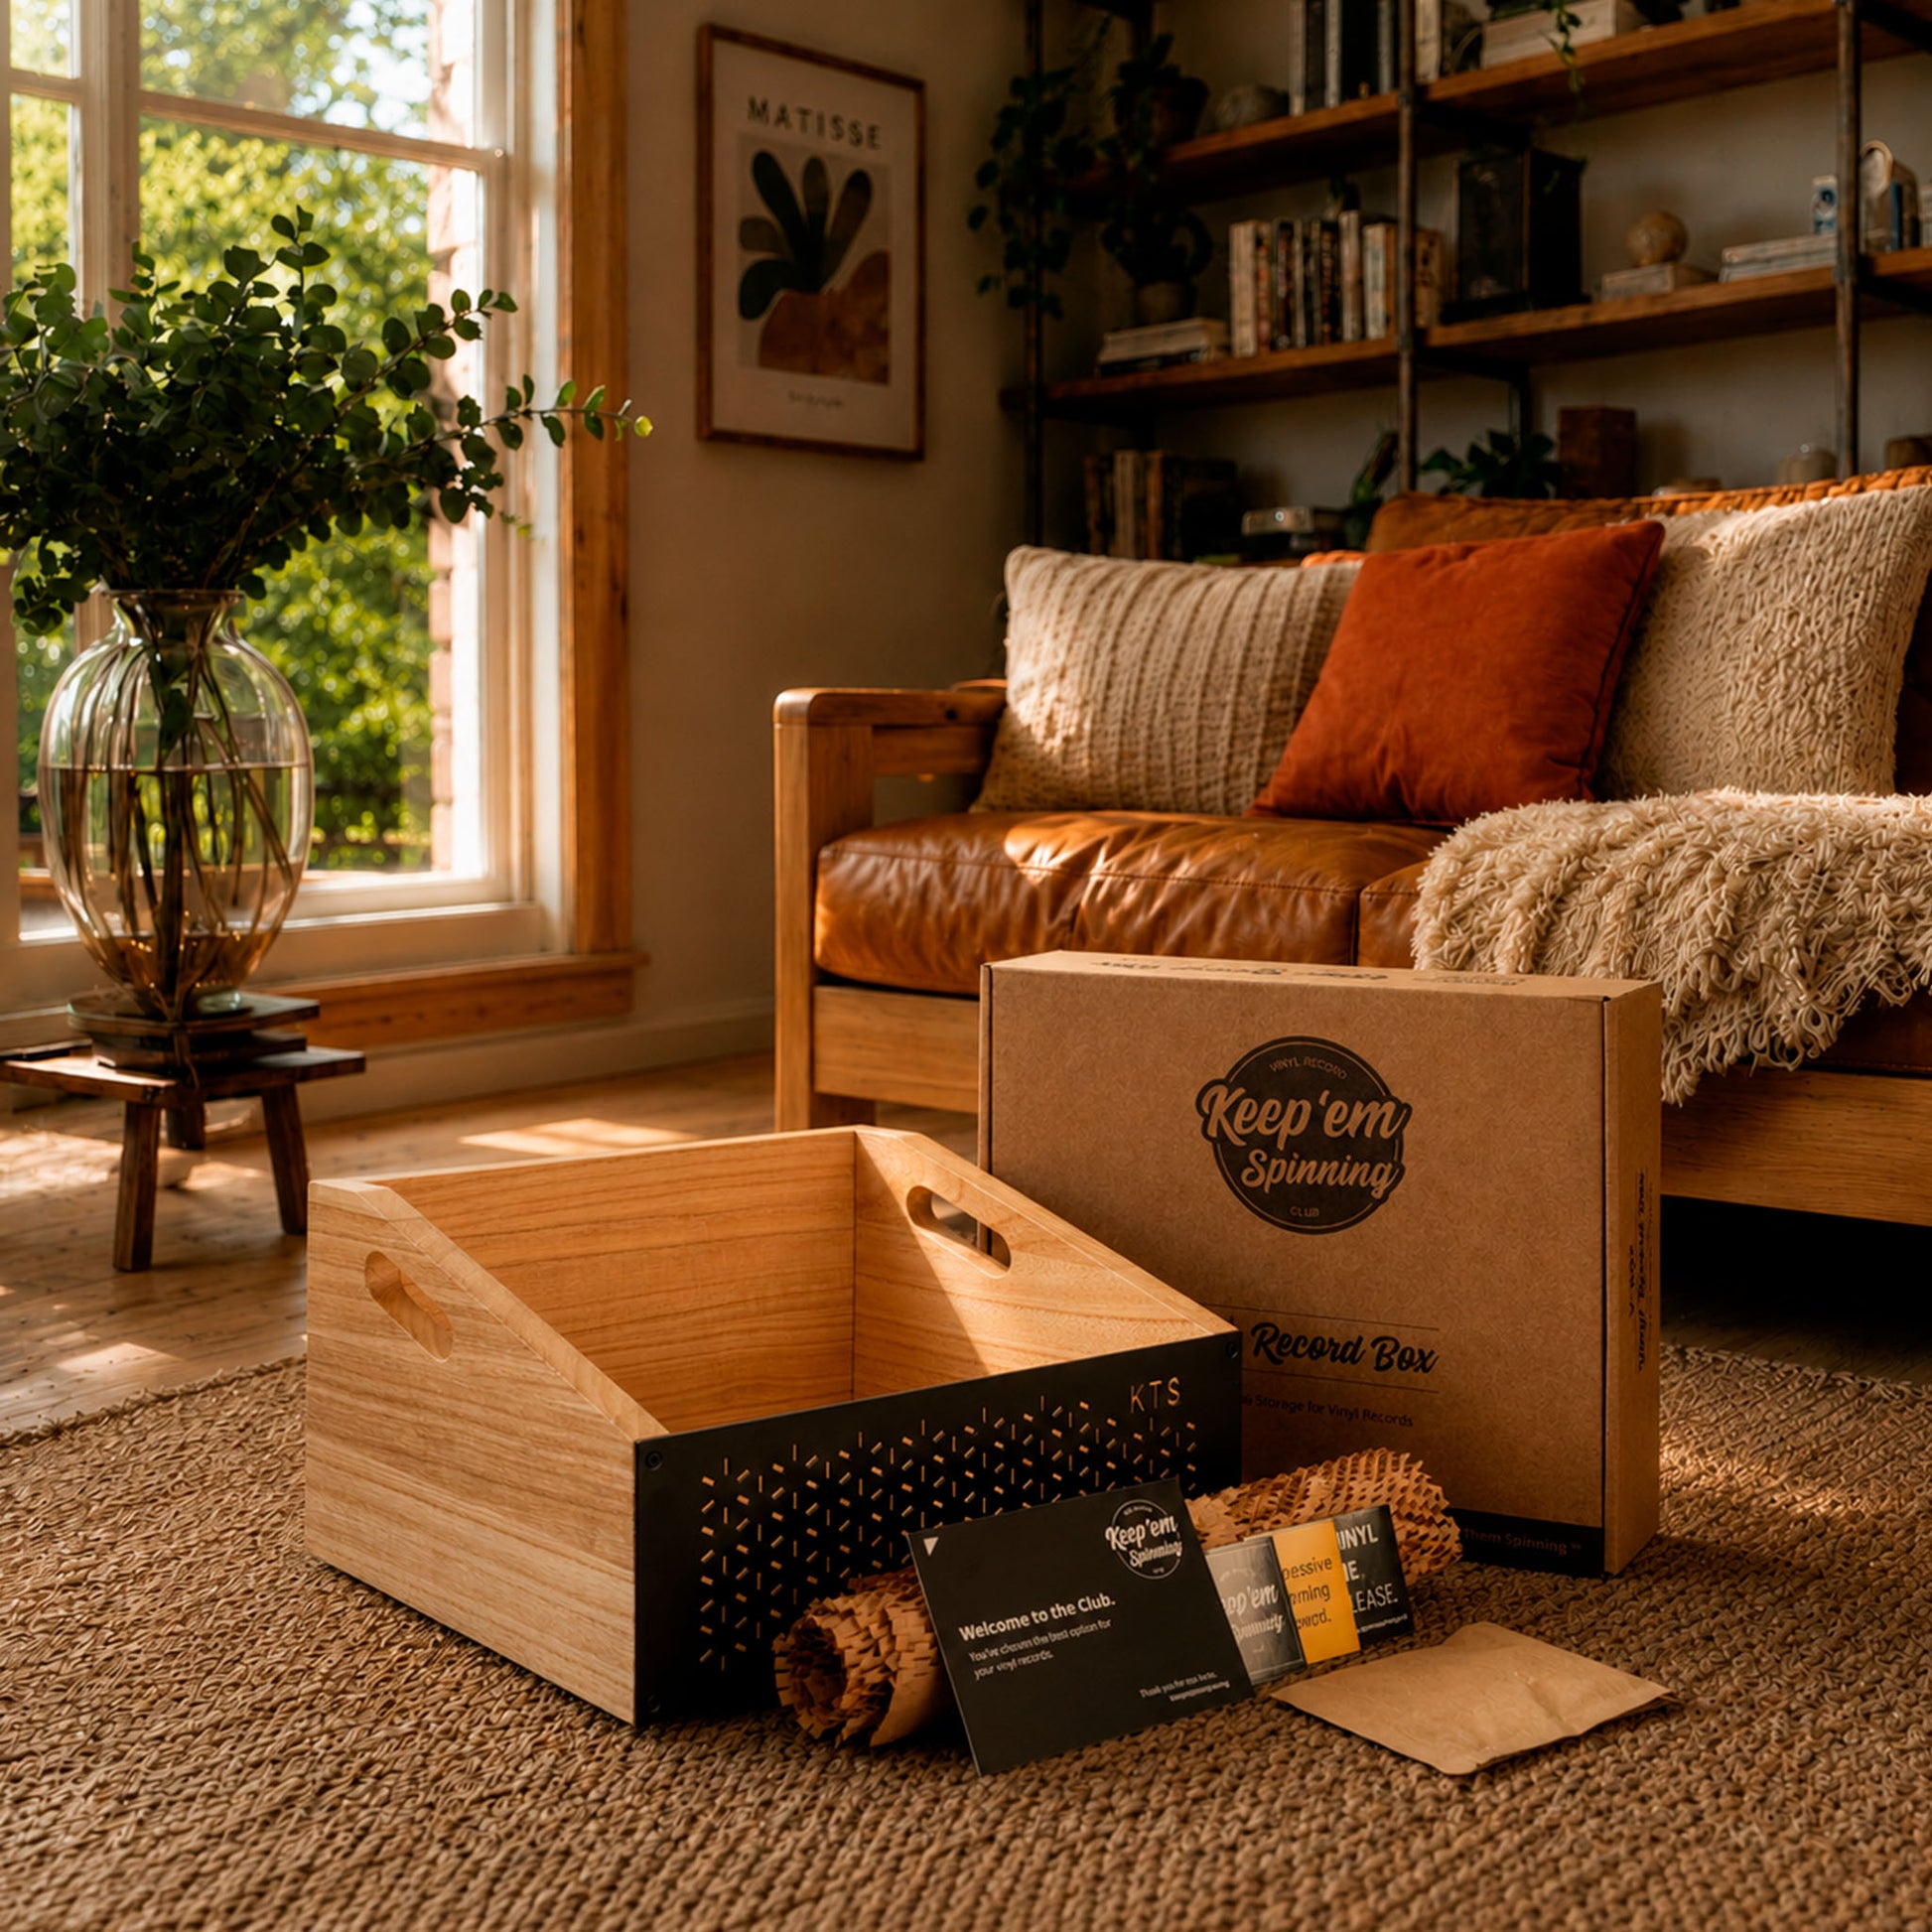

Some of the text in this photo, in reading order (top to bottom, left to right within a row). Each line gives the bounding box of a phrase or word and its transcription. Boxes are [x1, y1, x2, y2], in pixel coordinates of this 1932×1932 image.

[747, 96, 882, 150] MATISSE
[1240, 1149, 1401, 1200] Spinning
[1290, 1205, 1320, 1218] CLUB
[1250, 1321, 1440, 1374] Record Box
[1130, 1376, 1180, 1414] KTS
[1254, 1395, 1305, 1415] Storage
[1308, 1400, 1325, 1415] for
[1328, 1403, 1360, 1422] Vinyl
[1362, 1408, 1414, 1428] Records
[1463, 1527, 1502, 1544] Them
[959, 1591, 1117, 1641] Welcome to the Club.
[968, 1647, 1000, 1663] You've
[1097, 1618, 1113, 1630] for
[974, 1665, 995, 1682] your
